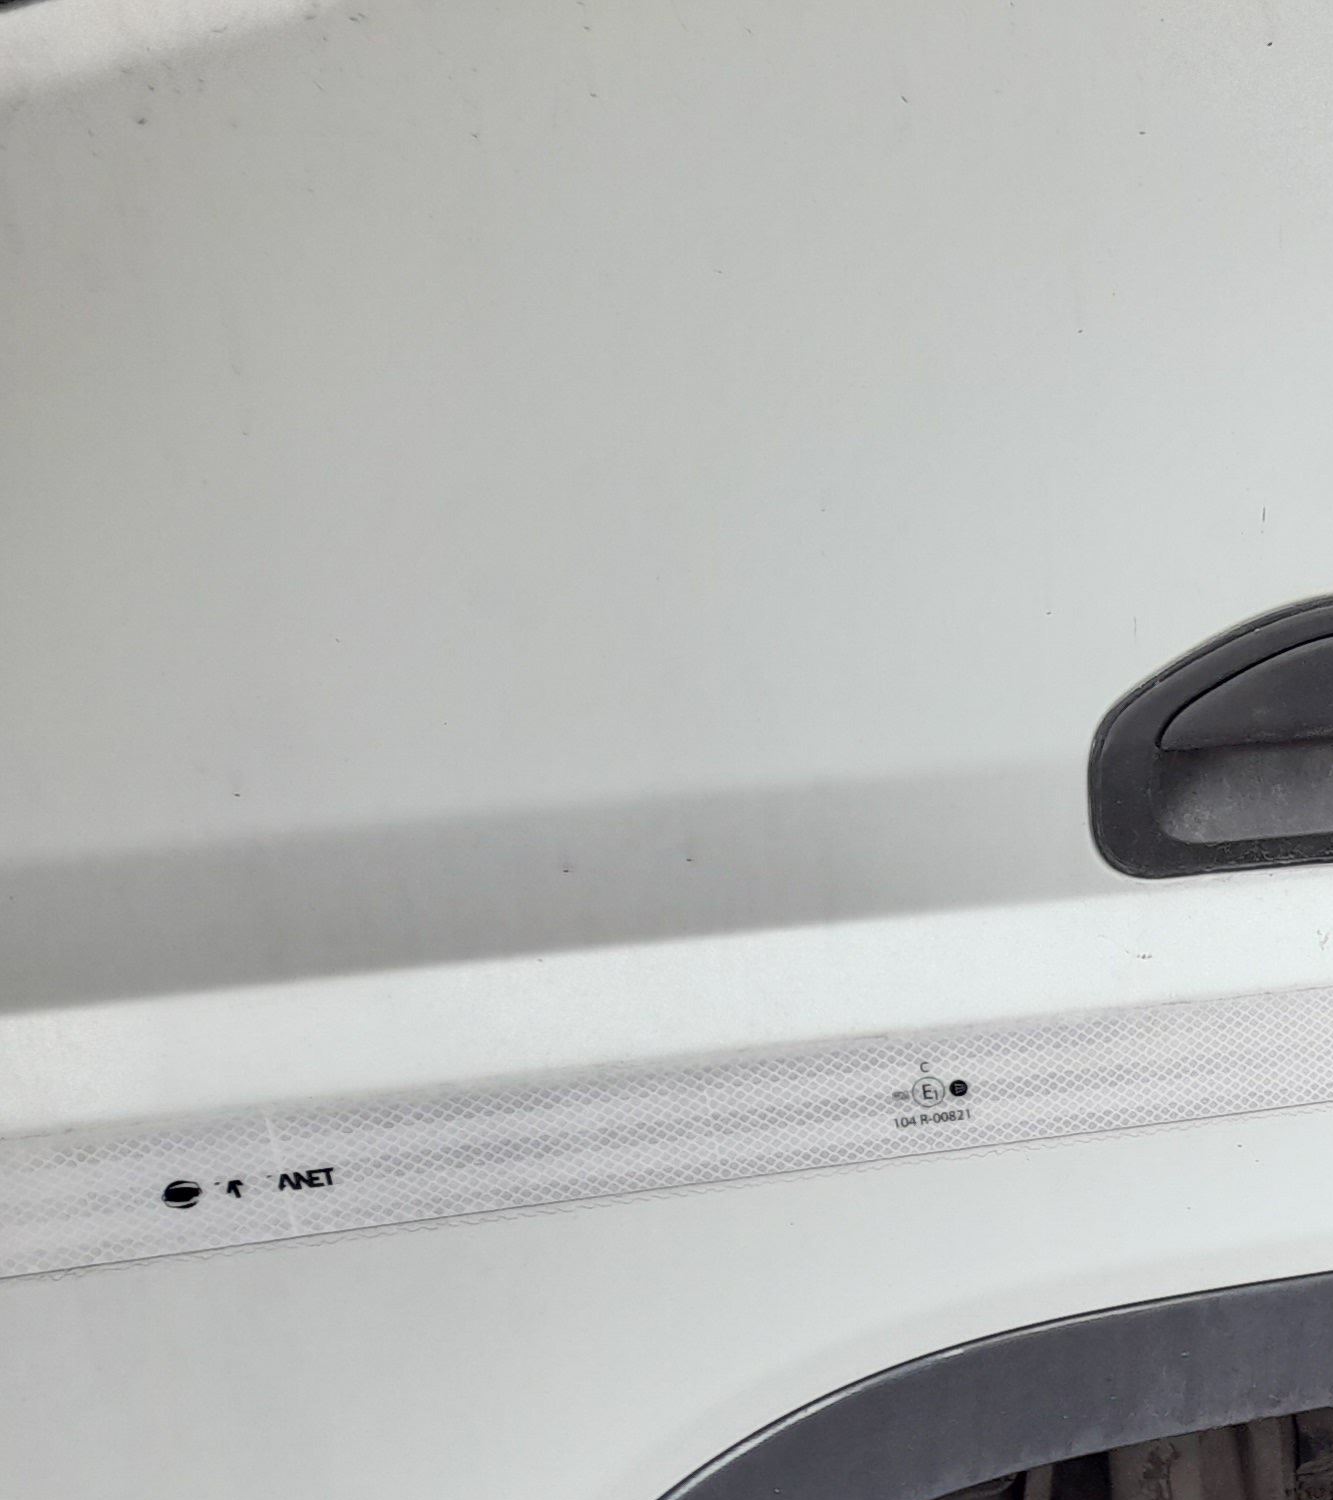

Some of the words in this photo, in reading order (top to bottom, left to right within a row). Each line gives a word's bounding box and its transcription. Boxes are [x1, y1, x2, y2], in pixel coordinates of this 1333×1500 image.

[919, 1061, 930, 1073] C
[893, 1116, 916, 1129] 104
[920, 1108, 971, 1126] R-00821
